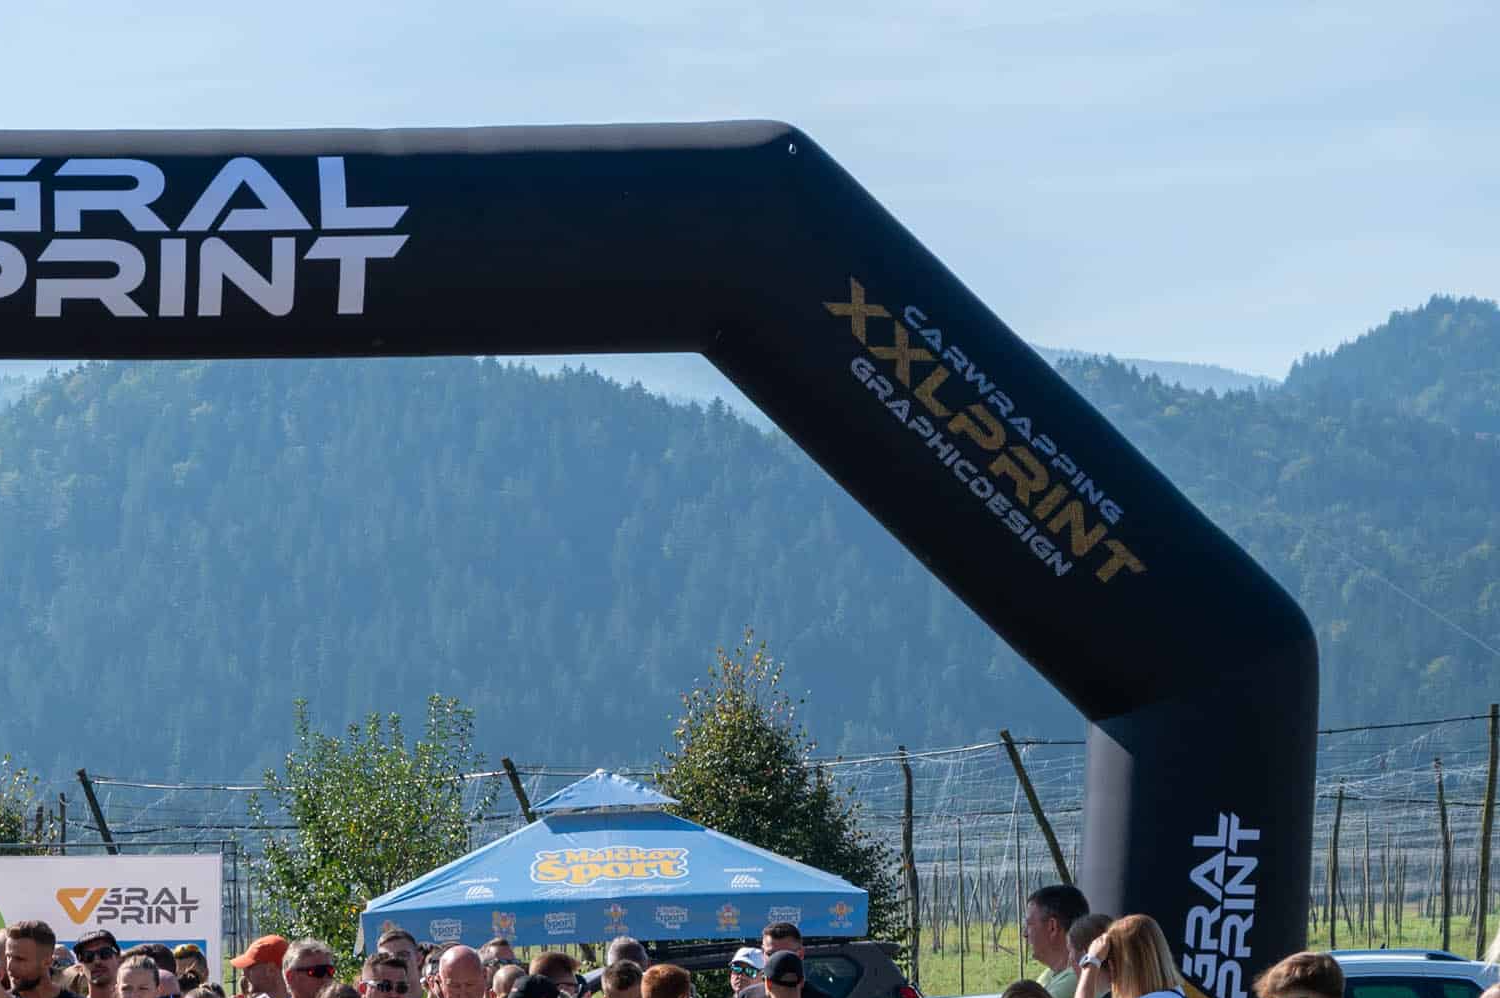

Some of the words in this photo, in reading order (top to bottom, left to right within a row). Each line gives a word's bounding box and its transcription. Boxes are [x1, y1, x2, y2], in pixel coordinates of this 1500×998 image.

[823, 275, 1148, 584] XXLPRINT
[851, 356, 1073, 577] GRAPHICDESIGN
[903, 305, 1124, 524] CARWRAPPING
[95, 905, 200, 924] PRINT
[536, 851, 683, 885] Šport
